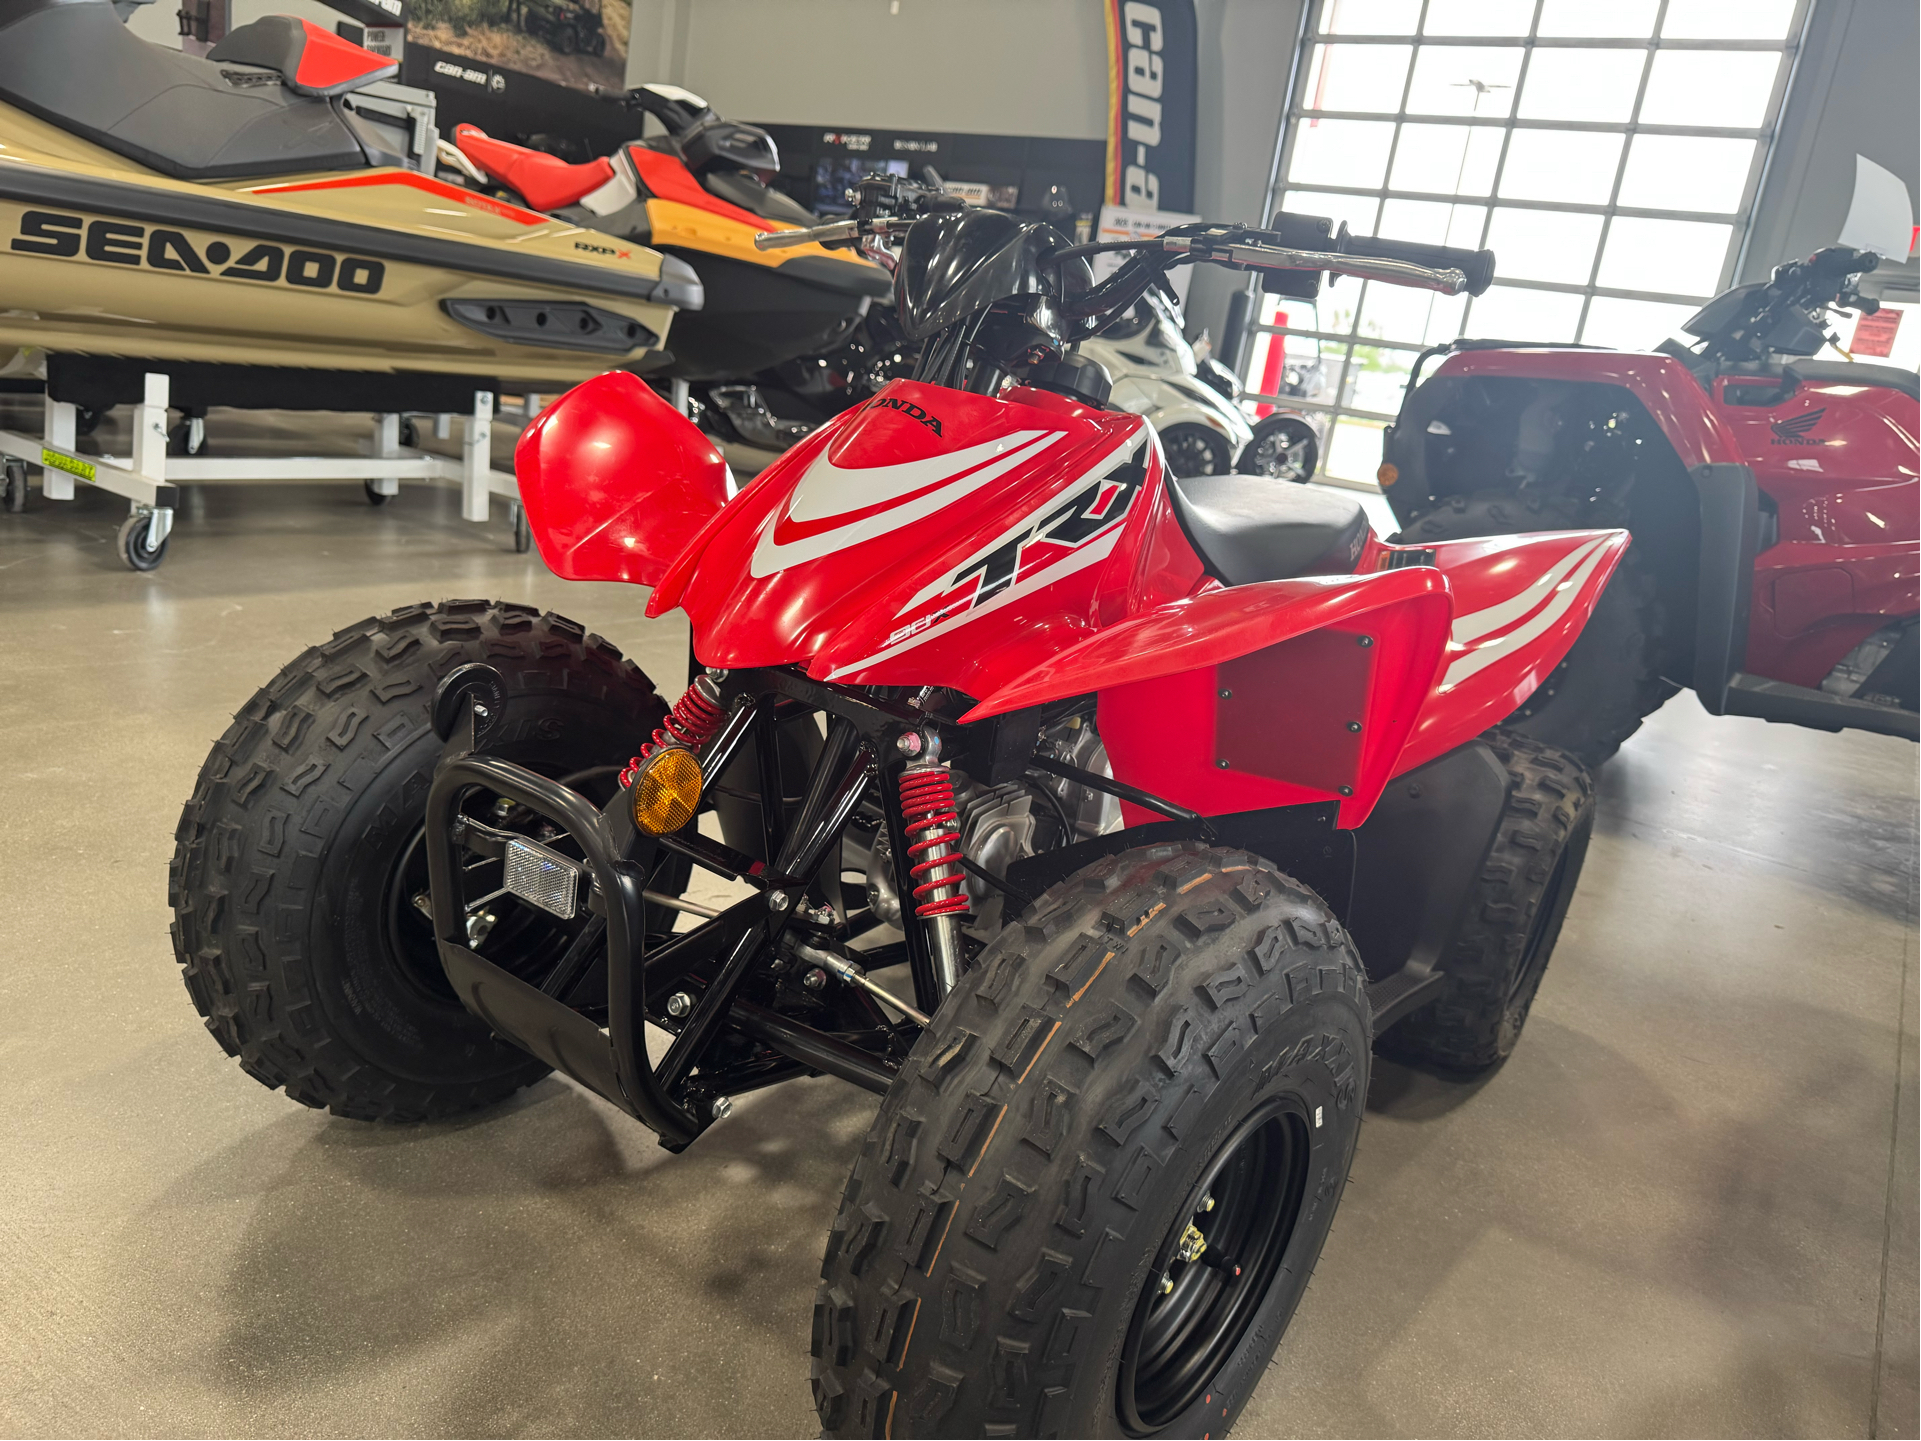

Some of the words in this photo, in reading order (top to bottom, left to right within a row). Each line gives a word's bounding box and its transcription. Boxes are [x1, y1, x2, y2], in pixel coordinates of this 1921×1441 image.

[434, 60, 487, 86] can-am
[866, 398, 943, 438] ONDA
[1770, 437, 1826, 447] HONDA
[949, 436, 1149, 610] TRX
[361, 716, 565, 851] MAXIS
[1250, 1032, 1357, 1112] MAXXIS
